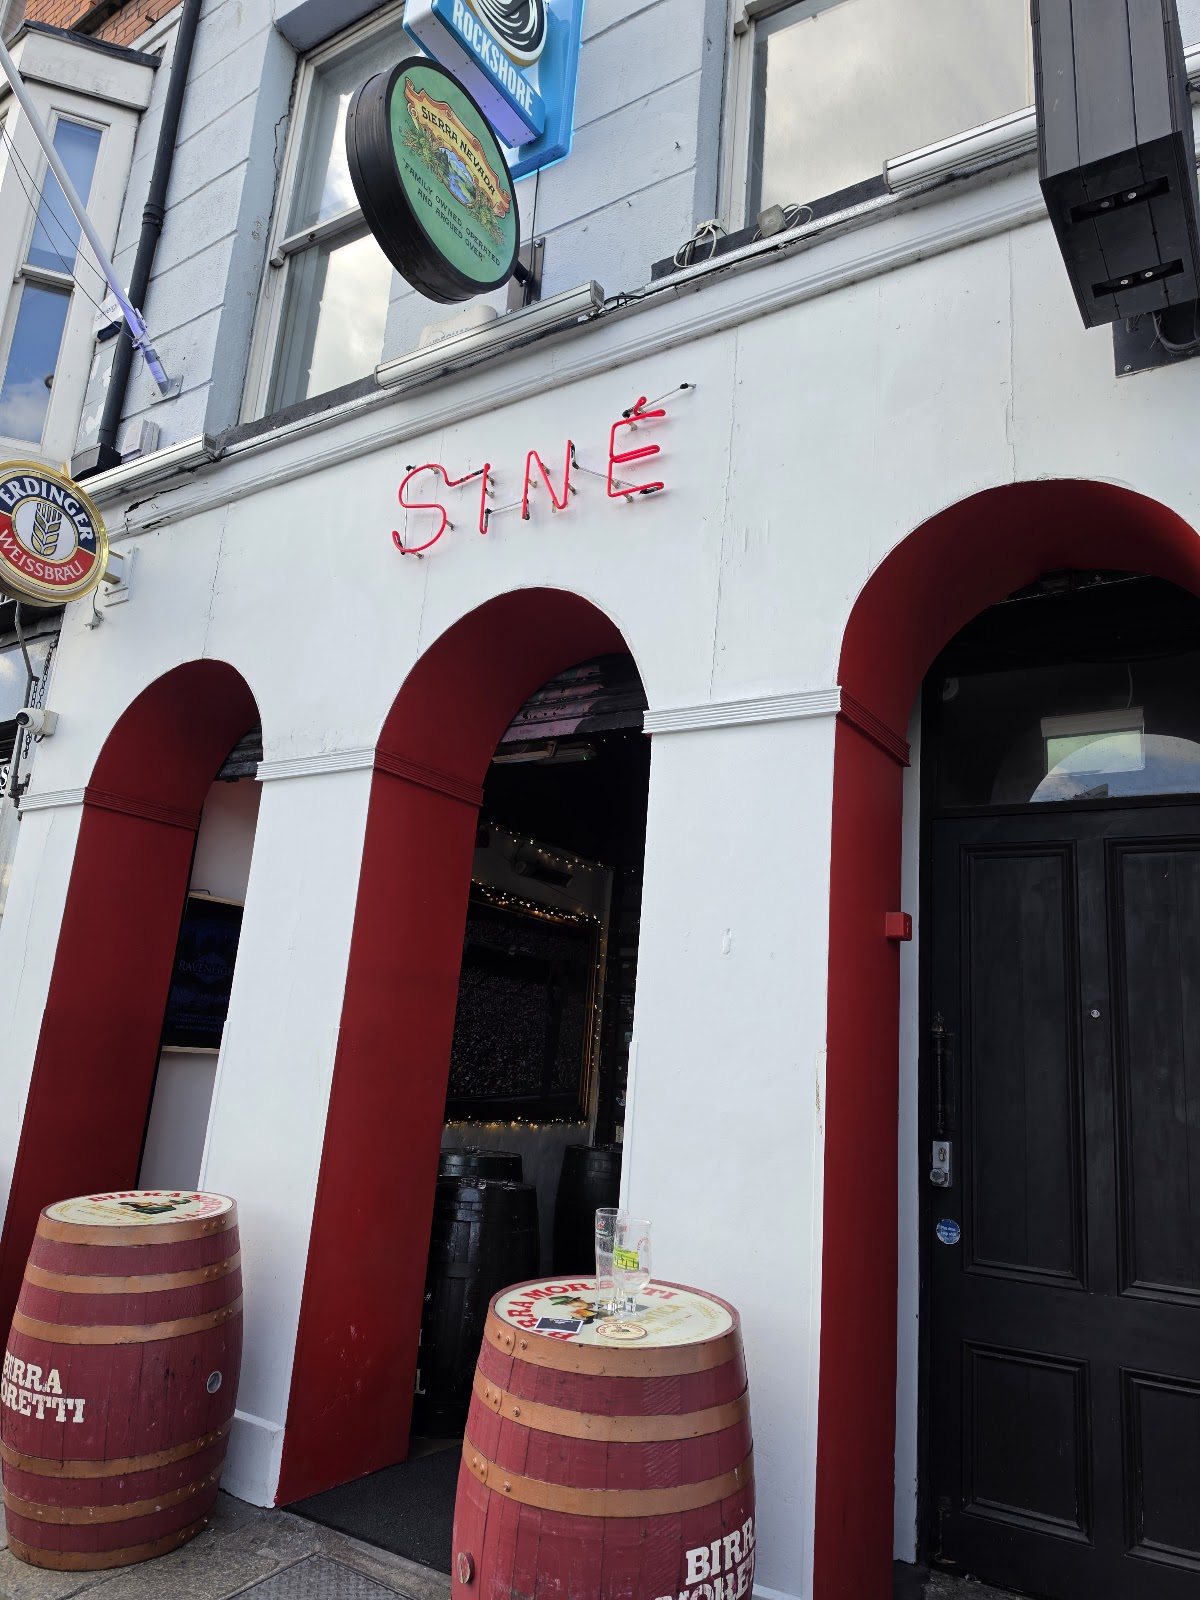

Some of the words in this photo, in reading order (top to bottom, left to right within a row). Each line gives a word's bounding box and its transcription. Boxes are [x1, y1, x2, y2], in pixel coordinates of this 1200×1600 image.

[452, 0, 534, 117] ROCKSHORE
[421, 105, 459, 144] SIERRA
[459, 142, 496, 196] NEVADA
[417, 188, 433, 208] AND
[435, 207, 463, 239] ARGUED
[465, 227, 501, 266] OPERATED
[0, 477, 94, 541] ERDINGER
[0, 529, 84, 582] WEISSBRÄU
[178, 959, 233, 976] RAVENLIGH
[506, 1300, 580, 1341] BRRA
[3, 1349, 63, 1394] BIRRA
[0, 1377, 86, 1423] ORETTI
[685, 1516, 756, 1585] BIRR
